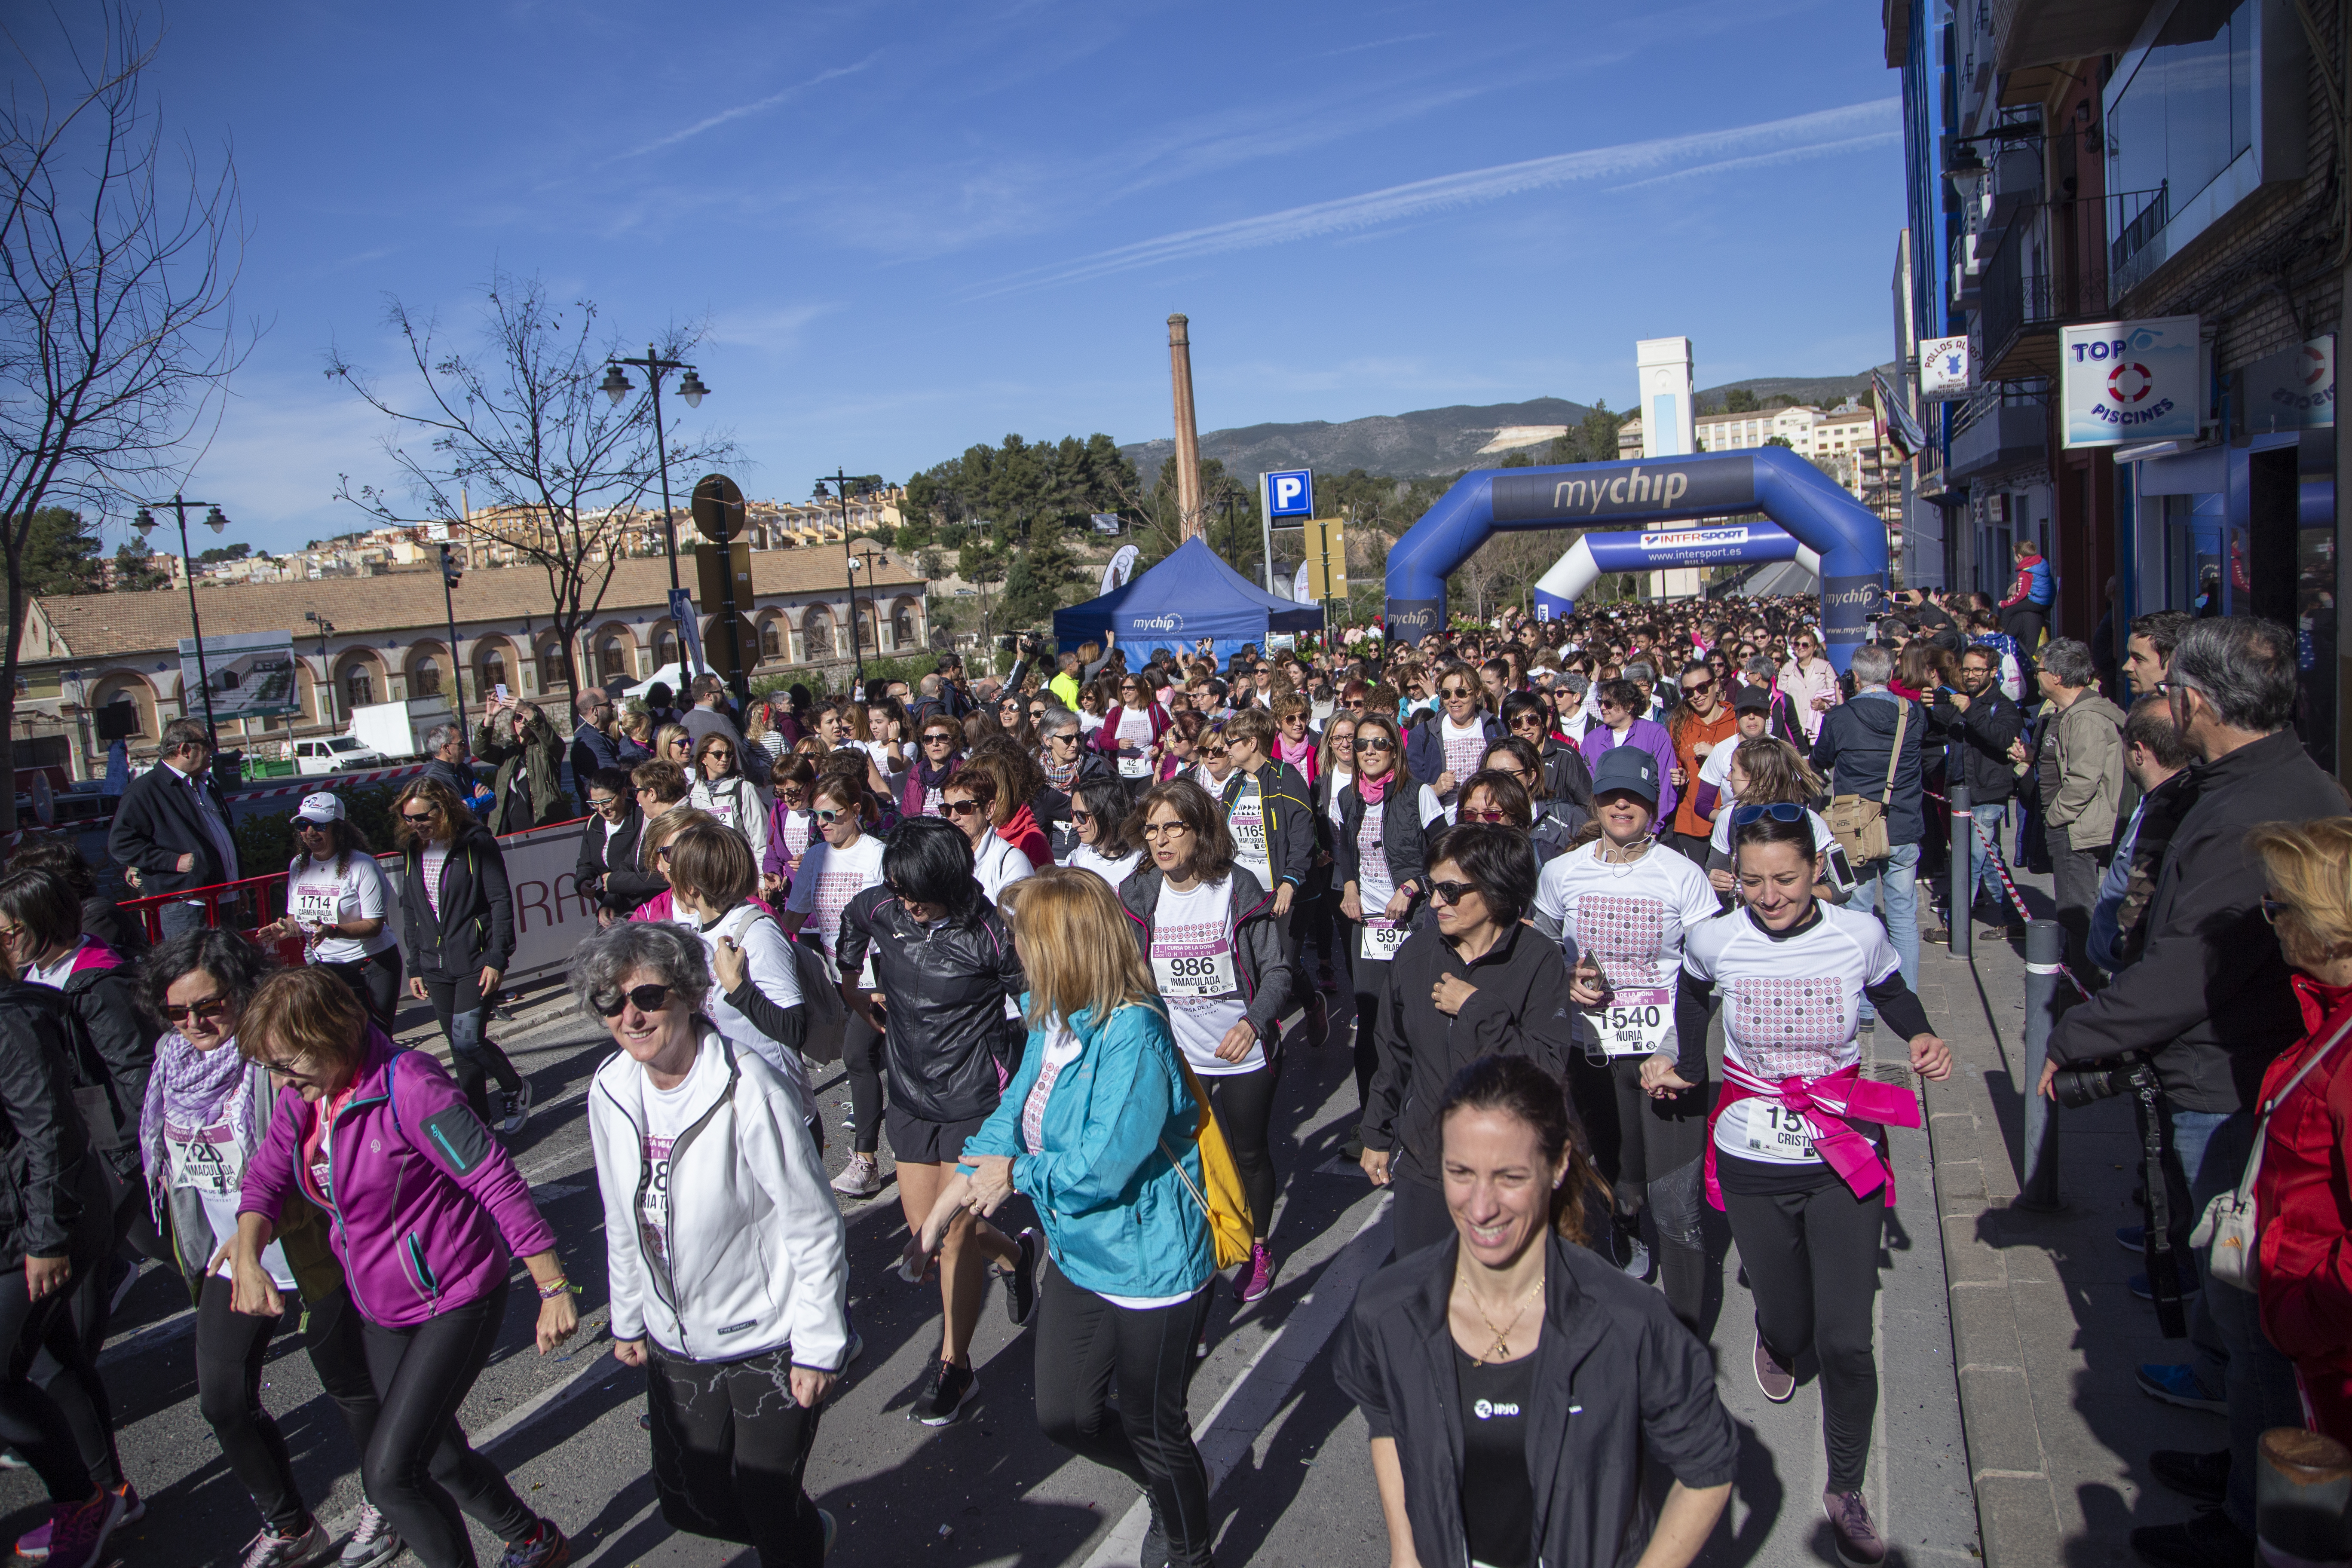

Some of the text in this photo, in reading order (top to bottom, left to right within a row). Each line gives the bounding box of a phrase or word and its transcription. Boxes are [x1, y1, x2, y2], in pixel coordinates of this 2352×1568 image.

[1925, 340, 1983, 368] POLLOS AL AST
[2072, 340, 2127, 362] TOP
[2091, 398, 2174, 426] PISCINES
[1277, 478, 1301, 508] P
[1554, 467, 1687, 514] mychip
[1661, 530, 1743, 545] INTERSPORT
[1648, 548, 1742, 561] www.intersport.es
[1825, 588, 1873, 607] mychip
[1133, 616, 1174, 631] mychip
[1388, 611, 1428, 626] mychip
[1826, 625, 1869, 635] www.mychi
[1236, 825, 1265, 837] 1165
[301, 896, 331, 909] 1714
[516, 873, 597, 933] RA
[1376, 928, 1405, 943] 597
[1155, 945, 1160, 953] 3
[1170, 957, 1215, 977] 986
[1170, 975, 1220, 986] INMACULADA
[1596, 1006, 1660, 1029] 1540
[1616, 1030, 1643, 1041] NURIA
[1767, 1106, 1802, 1132] 15
[657, 1140, 666, 1148] DE
[1778, 1132, 1813, 1147] CRISTI
[175, 1142, 224, 1163] 720
[185, 1164, 236, 1176] NMACULDA
[640, 1160, 668, 1191] 98
[637, 1193, 656, 1210] RIA
